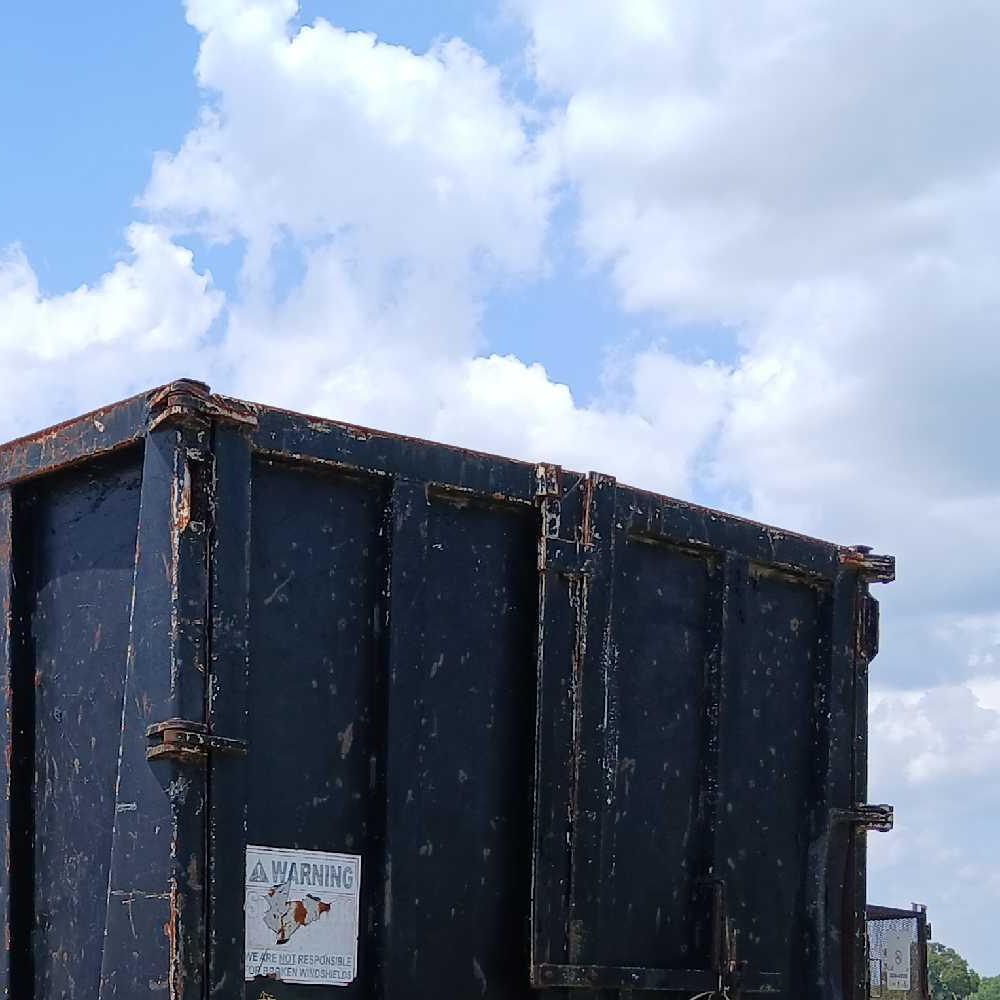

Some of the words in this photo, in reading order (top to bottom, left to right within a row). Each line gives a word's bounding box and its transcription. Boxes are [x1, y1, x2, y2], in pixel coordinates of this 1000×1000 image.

[271, 860, 353, 889] WARNING
[280, 953, 296, 965] NOT
[298, 954, 352, 967] RESPONSIBLE
[300, 968, 352, 980] WINDSHIELDS
